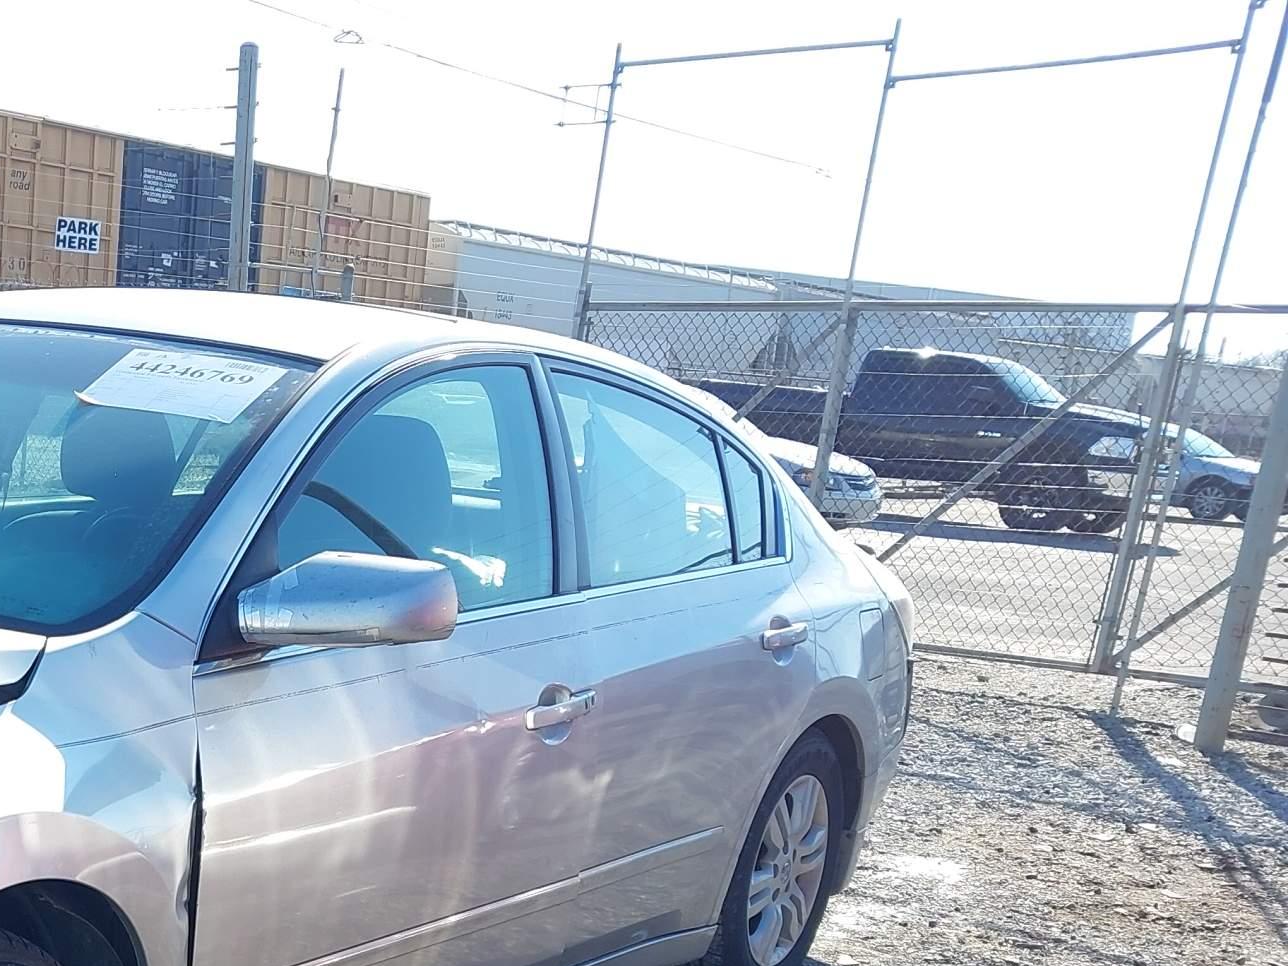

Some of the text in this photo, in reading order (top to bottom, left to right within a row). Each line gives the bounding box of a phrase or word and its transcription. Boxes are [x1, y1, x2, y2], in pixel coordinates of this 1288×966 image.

[10, 168, 28, 181] any
[9, 179, 31, 191] road
[57, 218, 100, 237] PARK
[55, 233, 98, 252] HERE
[129, 361, 255, 386] 44246769
